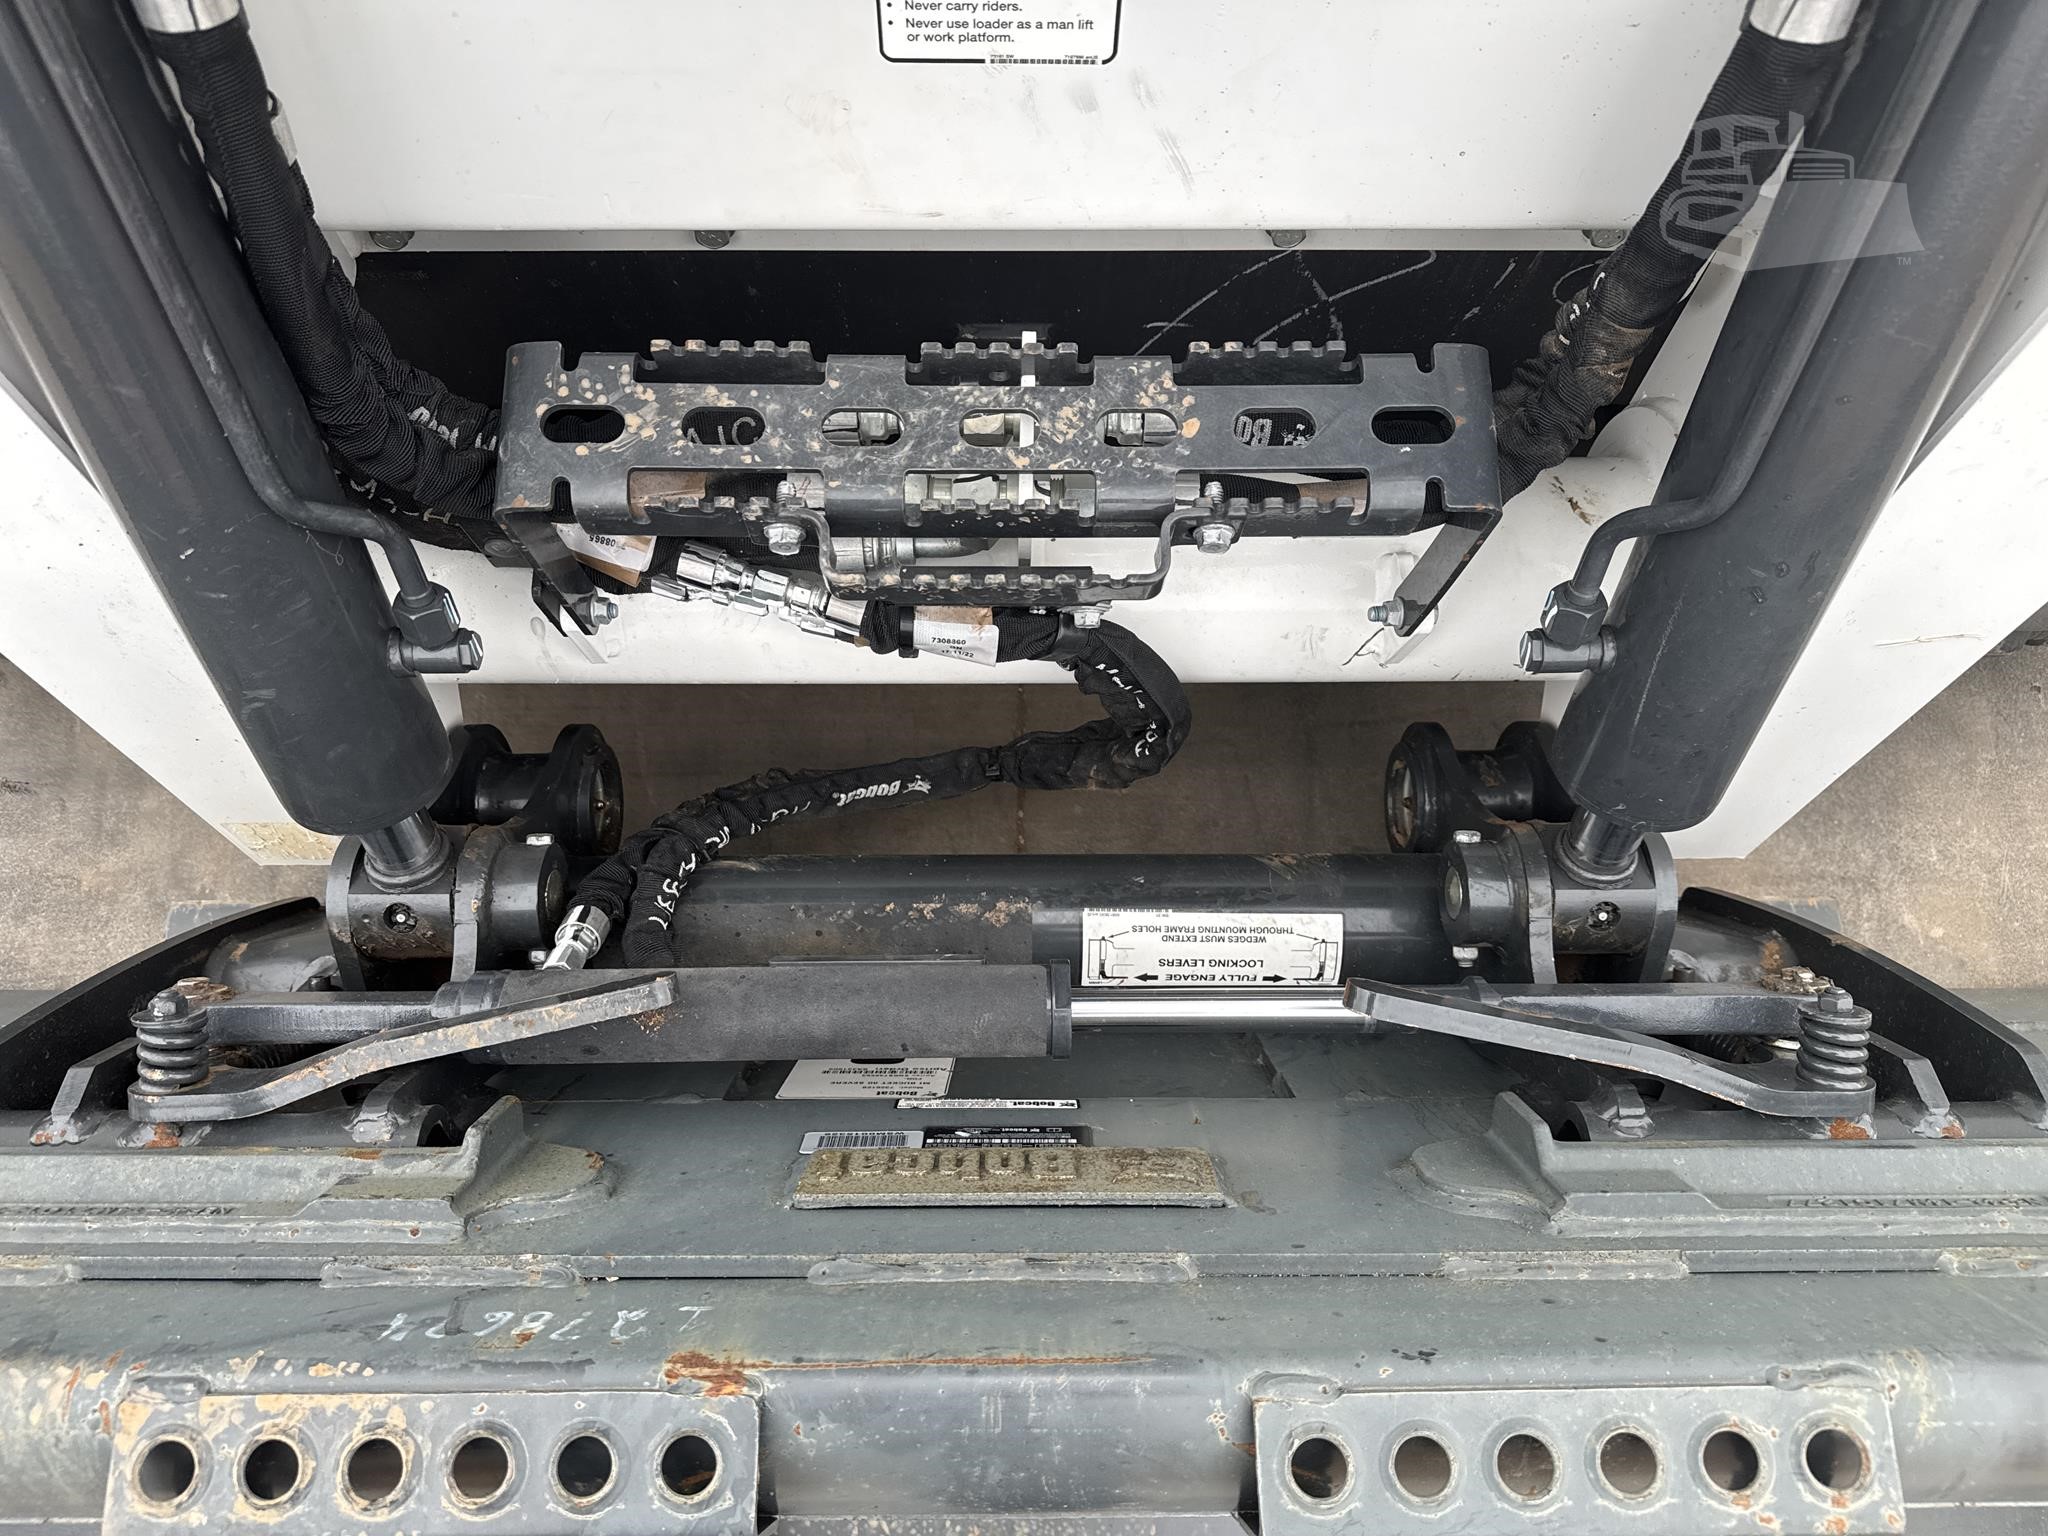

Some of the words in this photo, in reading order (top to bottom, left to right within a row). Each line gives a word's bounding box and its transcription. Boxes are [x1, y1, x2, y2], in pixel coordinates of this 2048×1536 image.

[904, 0, 942, 12] Never
[945, 2, 979, 14] carry
[981, 0, 1023, 13] riders.
[905, 17, 943, 30] Never
[946, 20, 970, 30] use
[972, 18, 1014, 30] loader
[1016, 20, 1032, 30] as
[1035, 20, 1044, 30] a
[1046, 20, 1075, 31] man
[1077, 18, 1095, 31] lift
[906, 33, 920, 43] or
[923, 31, 955, 43] work
[957, 31, 1016, 45] platform.
[1131, 925, 1162, 934] HOLES
[1163, 925, 1196, 934] FRAME
[1197, 925, 1247, 935] MOUNTING
[1248, 926, 1294, 935] THROUGH
[1161, 934, 1198, 943] EXTEND
[1199, 934, 1226, 944] MUST
[1226, 934, 1267, 944] WEDGES
[1158, 957, 1205, 968] LEVERS
[1207, 957, 1264, 968] LOCKING
[1164, 973, 1217, 982] ENGAGE
[1217, 973, 1258, 982] FULLY
